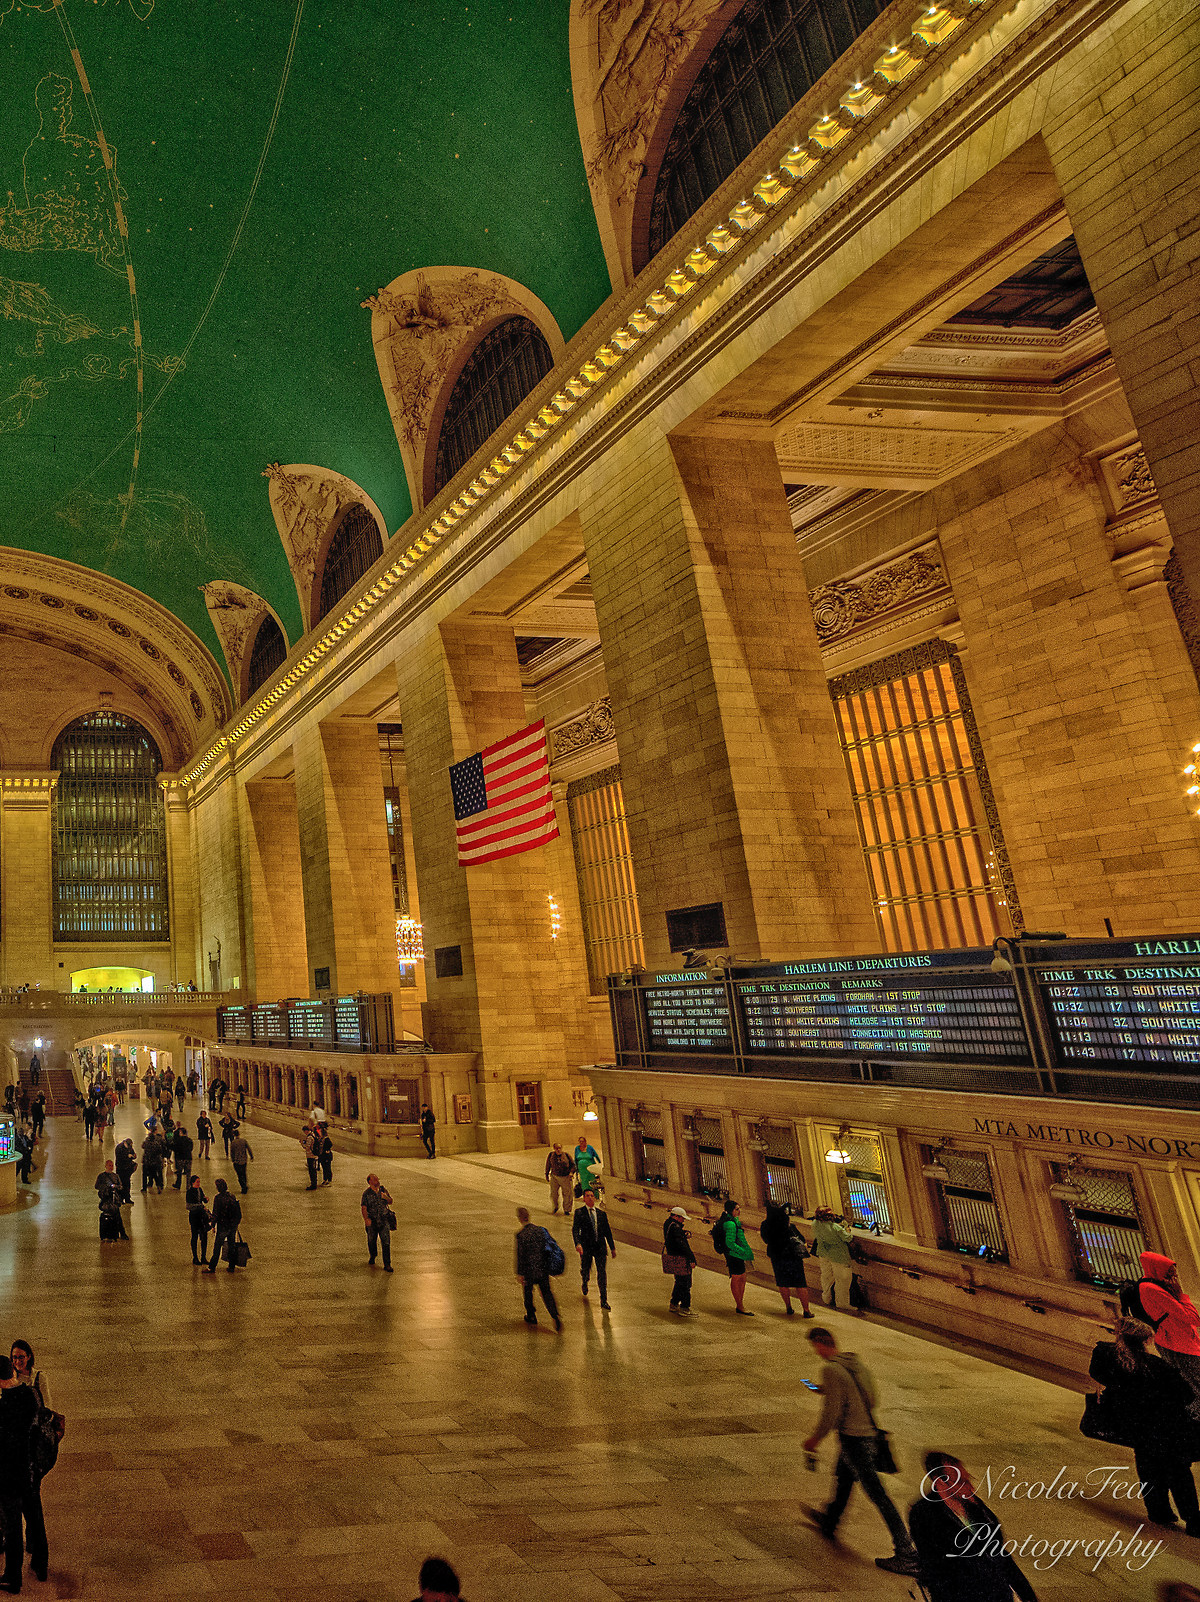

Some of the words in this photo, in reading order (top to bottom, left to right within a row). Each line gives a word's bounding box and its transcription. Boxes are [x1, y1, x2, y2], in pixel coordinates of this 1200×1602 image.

[784, 962, 827, 975] HARLEM
[828, 961, 855, 972] LINE
[856, 955, 932, 971] DEPARTURES
[655, 971, 708, 983] INFORMATION
[1040, 970, 1075, 982] TIME
[1083, 969, 1117, 980] TRK
[740, 985, 757, 993] TIME
[760, 984, 776, 993] TRK
[779, 981, 831, 992] DESTINATION
[841, 979, 884, 989] REMARKS
[1048, 985, 1081, 997] 10:22
[1104, 985, 1120, 997] 33
[1132, 984, 1200, 997] SOUTHEAST
[792, 995, 811, 1003] WHITE
[813, 994, 836, 1002] PLAINS
[846, 992, 875, 1001] FORDHAM
[886, 991, 899, 1000] 1ST
[902, 991, 921, 1000] STOP
[747, 1007, 761, 1015] 9:22
[784, 1006, 816, 1014] SOUTHEAST
[847, 1004, 868, 1014] WHITE
[871, 1004, 897, 1013] PLAINS
[909, 1003, 923, 1013] 1ST
[926, 1003, 946, 1012] STOP
[1052, 1001, 1085, 1012] 10:32
[1109, 1001, 1123, 1013] 17
[1136, 1001, 1151, 1013] N.
[1158, 1000, 1200, 1013] WHITE
[773, 1017, 781, 1026] 17
[796, 1017, 815, 1026] WHITE
[816, 1017, 840, 1026] PLAINS
[849, 1016, 879, 1026] MELROSE
[890, 1016, 903, 1026] 1ST
[907, 1016, 926, 1026] STOP
[1055, 1016, 1089, 1028] 11:04
[1113, 1016, 1129, 1028] 32
[750, 1028, 764, 1036] 9:52
[788, 1028, 820, 1037] SOUTHEAST
[851, 1029, 894, 1038] CONNECTION
[896, 1029, 906, 1038] TO
[909, 1029, 943, 1039] WASSAIC
[1059, 1031, 1092, 1043] 11:13
[1118, 1033, 1133, 1044] 16
[1145, 1033, 1160, 1044] N.
[1167, 1033, 1200, 1046] WHIT
[749, 1039, 766, 1047] 10:00
[800, 1040, 819, 1048] WHITE
[820, 1040, 844, 1049] PLAINS
[853, 1041, 884, 1050] FORDHAM
[895, 1042, 908, 1051] 1ST
[912, 1042, 931, 1051] STOP
[1062, 1046, 1096, 1058] 11:43
[1122, 1048, 1137, 1060] 17
[1150, 1049, 1165, 1061] N.
[1172, 1050, 1200, 1063] WHI
[973, 1117, 1020, 1137] MTA
